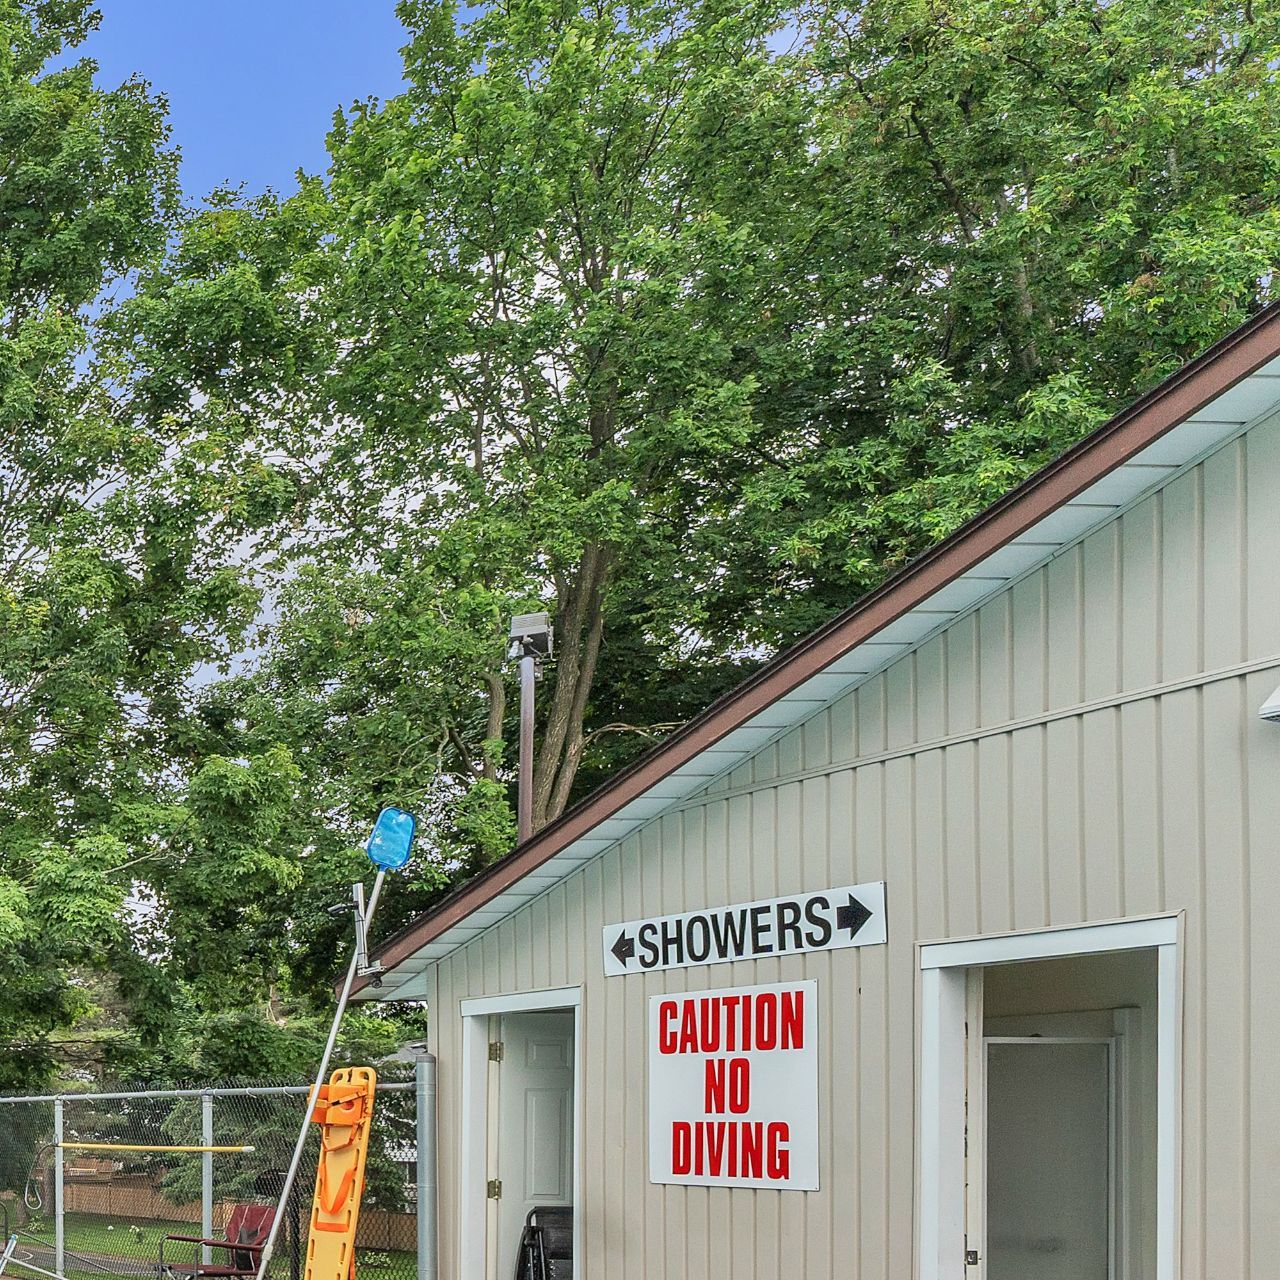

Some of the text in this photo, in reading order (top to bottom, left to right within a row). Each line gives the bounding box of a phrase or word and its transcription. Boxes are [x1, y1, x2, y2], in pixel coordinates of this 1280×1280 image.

[638, 896, 832, 969] SHOWERS
[659, 991, 805, 1055] CAUTION
[704, 1057, 751, 1115] NO
[671, 1121, 790, 1180] DIVING
